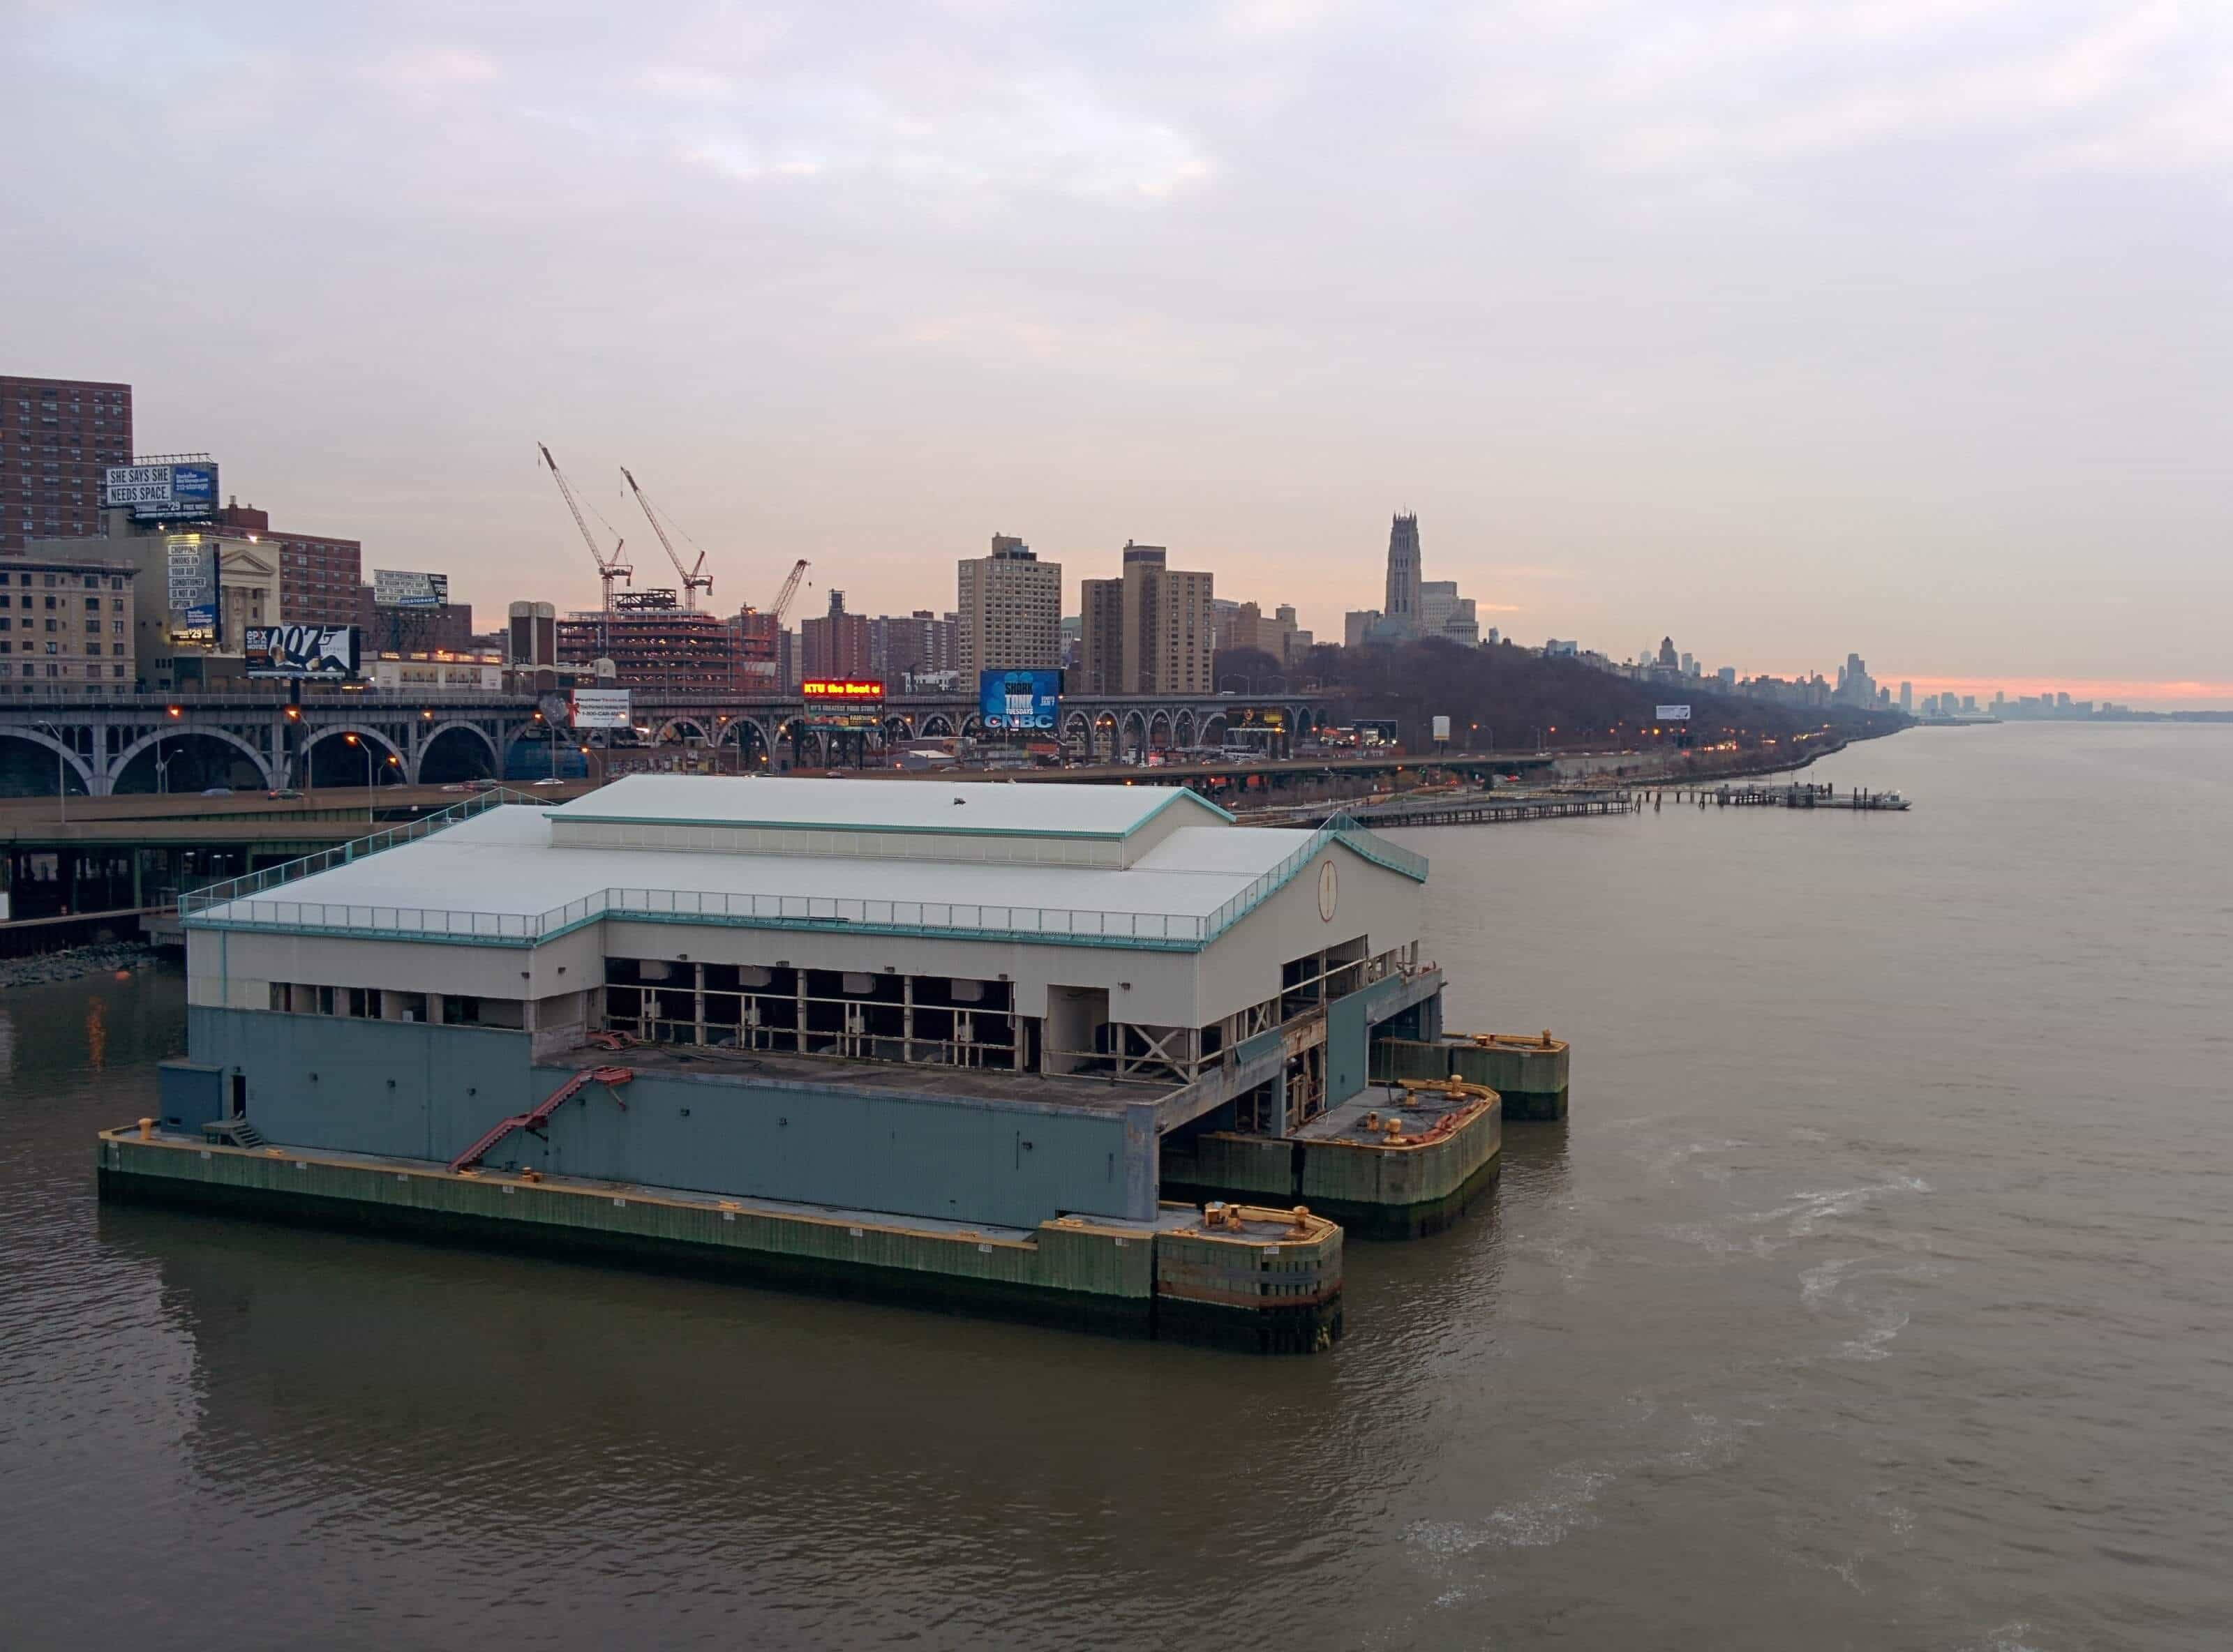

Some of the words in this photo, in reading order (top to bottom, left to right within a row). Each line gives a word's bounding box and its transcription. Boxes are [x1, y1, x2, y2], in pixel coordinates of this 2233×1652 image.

[110, 470, 126, 483] SHE
[128, 469, 149, 483] SAYS
[152, 467, 168, 481] SHE
[111, 487, 137, 501] NEEDS
[140, 486, 169, 500] SPACE.
[171, 546, 196, 554] CHOPPING
[172, 578, 204, 587] CONDITIONER
[179, 590, 188, 598] NOT
[189, 590, 196, 598] AN
[268, 626, 324, 657] 007
[804, 684, 826, 693] KTU
[827, 684, 844, 693] the
[1005, 683, 1033, 695] SHARK
[1005, 694, 1033, 709] TANK
[984, 714, 1054, 728] CNBC
